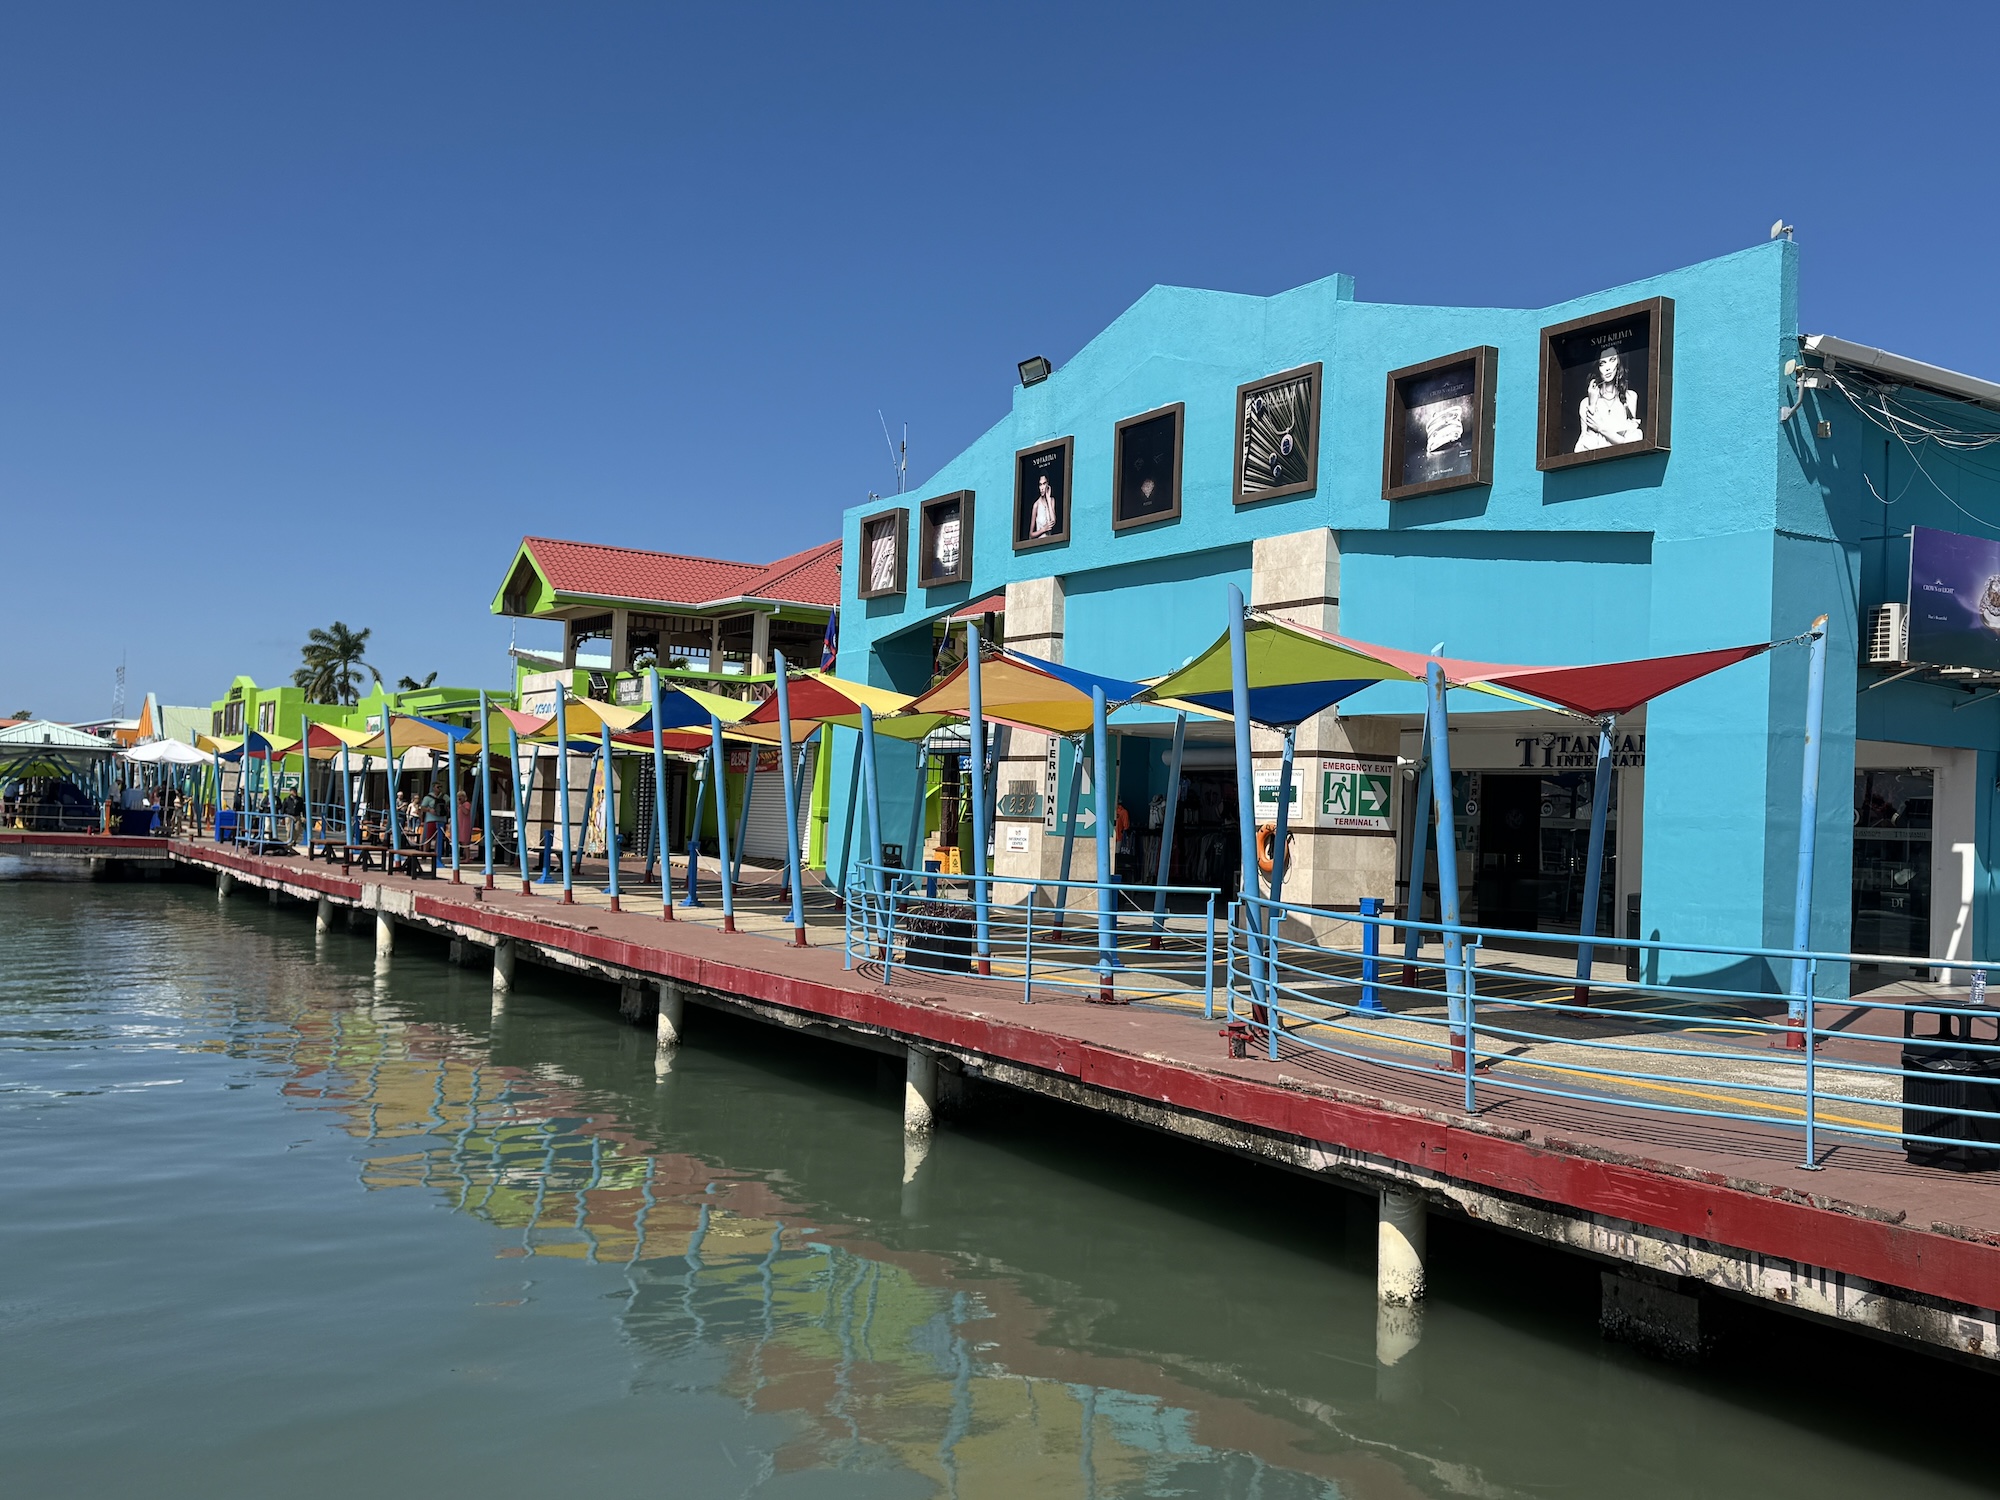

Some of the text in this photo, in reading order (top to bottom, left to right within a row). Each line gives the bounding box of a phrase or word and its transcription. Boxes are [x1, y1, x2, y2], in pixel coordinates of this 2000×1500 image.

[1322, 761, 1393, 773] EMERGENCY EXIT
[1046, 738, 1057, 827] TERMINAL
[1334, 817, 1379, 827] TERMINAL 1
